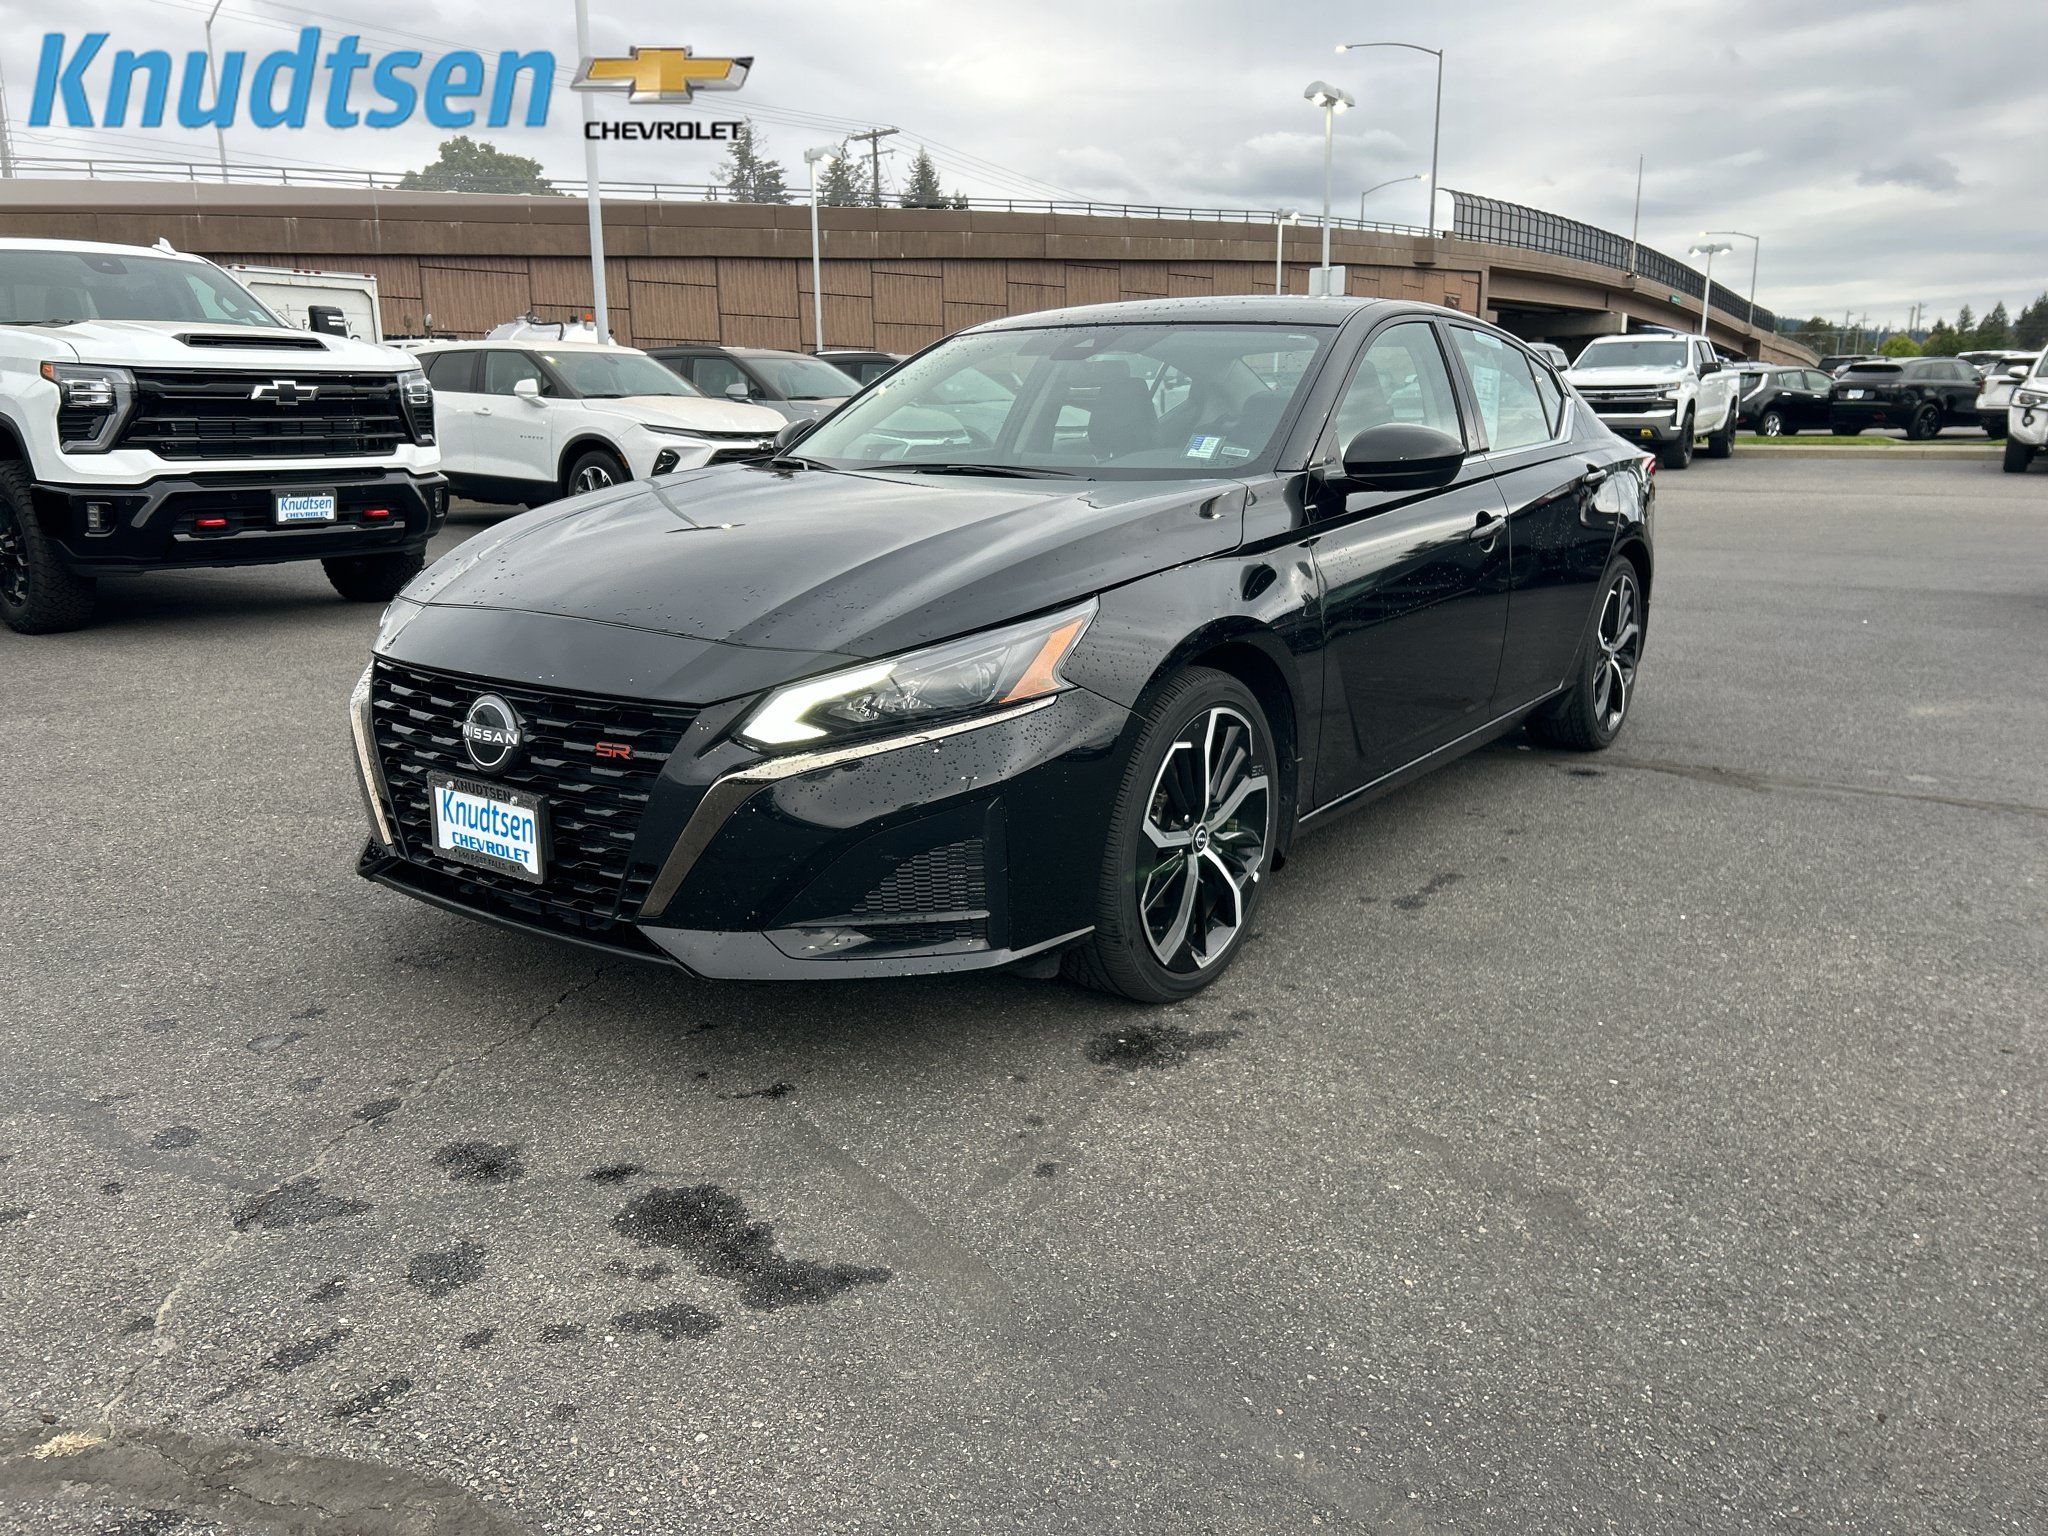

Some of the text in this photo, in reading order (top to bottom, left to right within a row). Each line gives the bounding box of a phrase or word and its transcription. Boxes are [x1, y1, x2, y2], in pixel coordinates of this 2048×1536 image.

[280, 496, 332, 511] Knudtsen
[285, 510, 329, 518] CHEVROLET
[462, 723, 518, 745] NISSAN
[595, 741, 634, 760] SR
[453, 778, 511, 800] KNUDTSEN
[442, 789, 534, 844] Knudtsen
[451, 831, 530, 863] CHEVROLET
